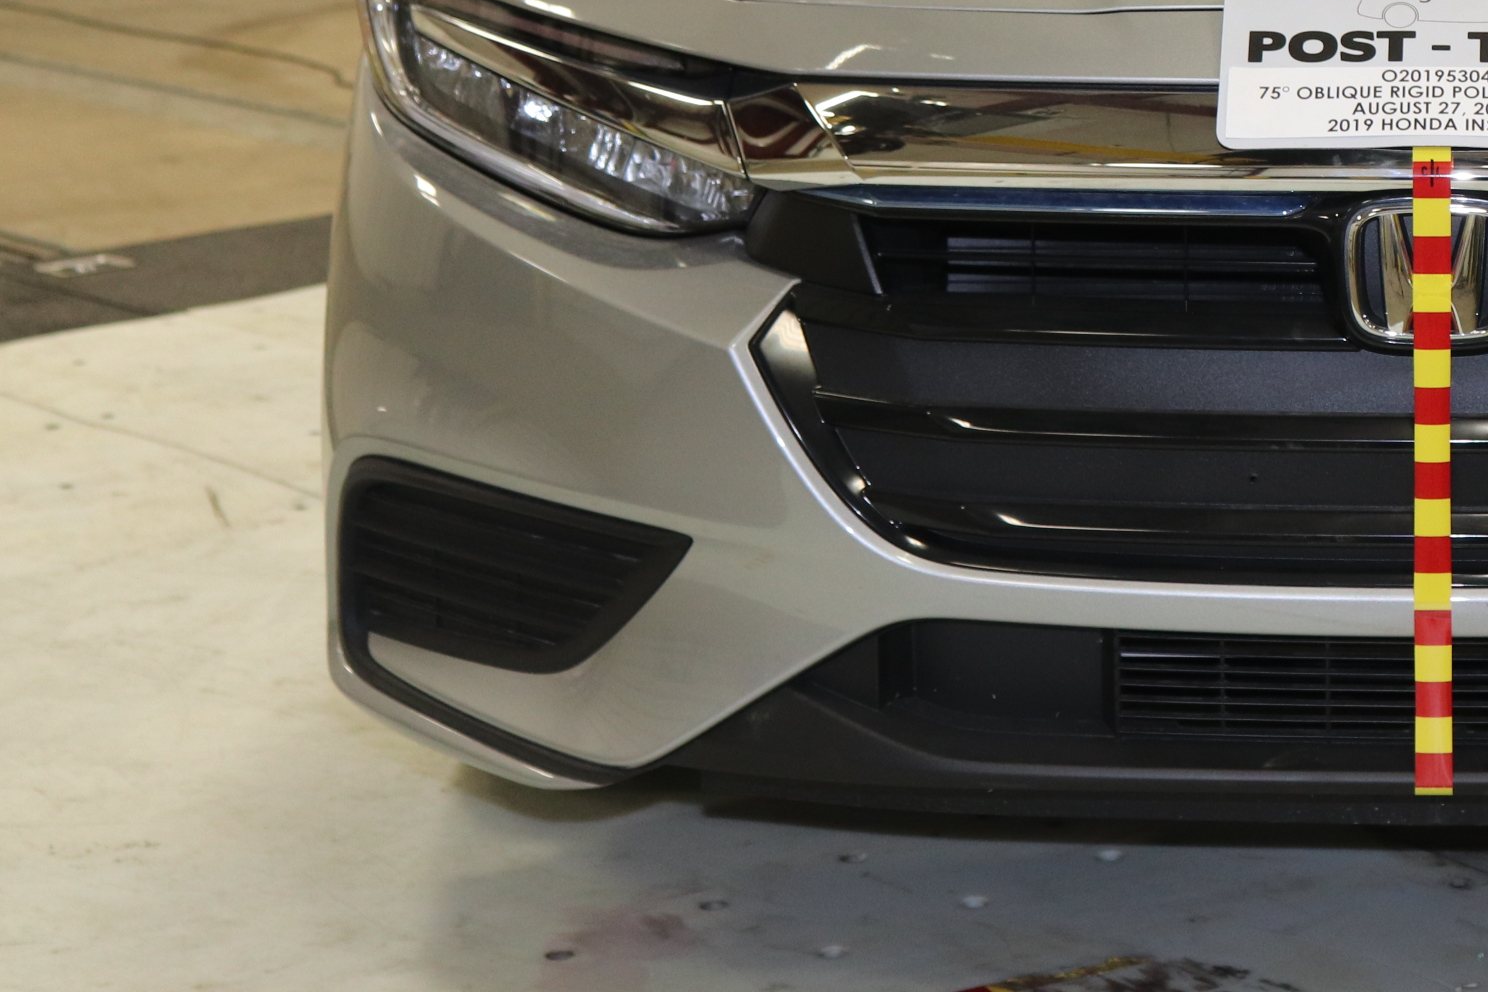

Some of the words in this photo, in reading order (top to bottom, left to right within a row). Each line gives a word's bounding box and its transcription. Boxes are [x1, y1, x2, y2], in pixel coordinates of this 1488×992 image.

[1247, 30, 1417, 63] POST
[1296, 86, 1383, 100] OBLIQUE
[1390, 85, 1445, 99] RIGID
[1352, 101, 1432, 115] AUGUST
[1438, 102, 1466, 117] 27,
[1327, 118, 1374, 132] 2019
[1381, 117, 1458, 131] HONDA
